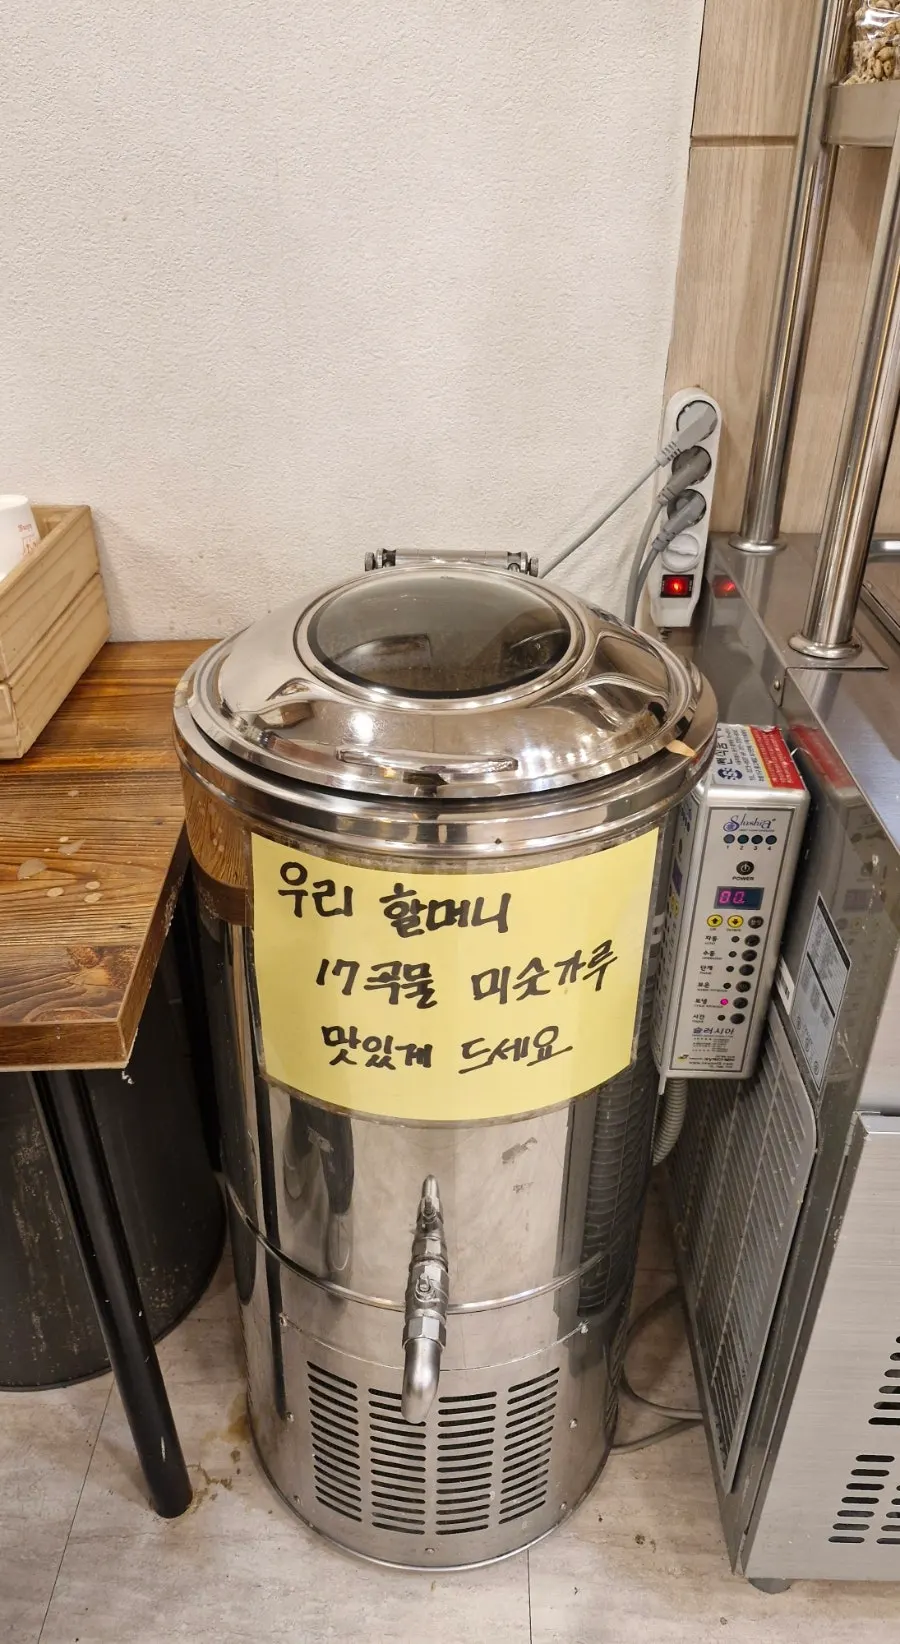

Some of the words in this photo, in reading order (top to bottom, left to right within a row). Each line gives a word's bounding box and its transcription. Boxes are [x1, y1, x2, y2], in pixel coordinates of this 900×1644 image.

[277, 861, 354, 918] 우리
[379, 882, 511, 939] 할머니
[470, 939, 618, 1005] 미숫가루
[320, 1025, 433, 1071] 맛있게
[458, 1025, 573, 1074] 드세요
